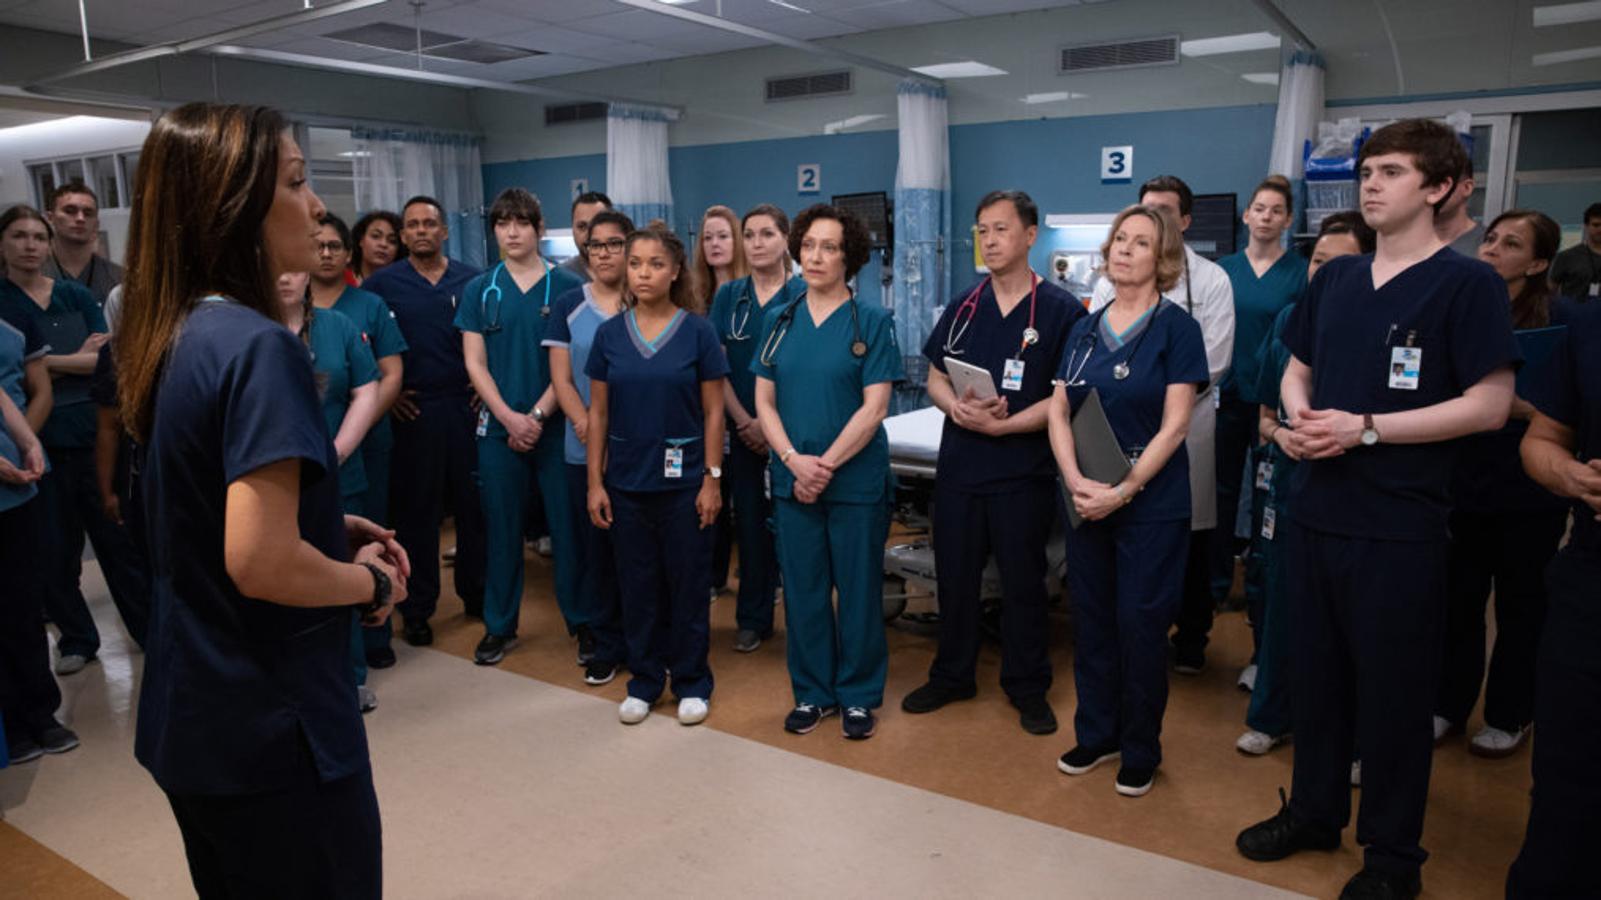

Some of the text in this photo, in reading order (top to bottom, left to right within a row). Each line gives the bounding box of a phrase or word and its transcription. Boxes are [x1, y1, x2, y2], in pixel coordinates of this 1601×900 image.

[1108, 151, 1125, 174] 3
[802, 168, 816, 187] 2
[575, 182, 584, 196] 1
